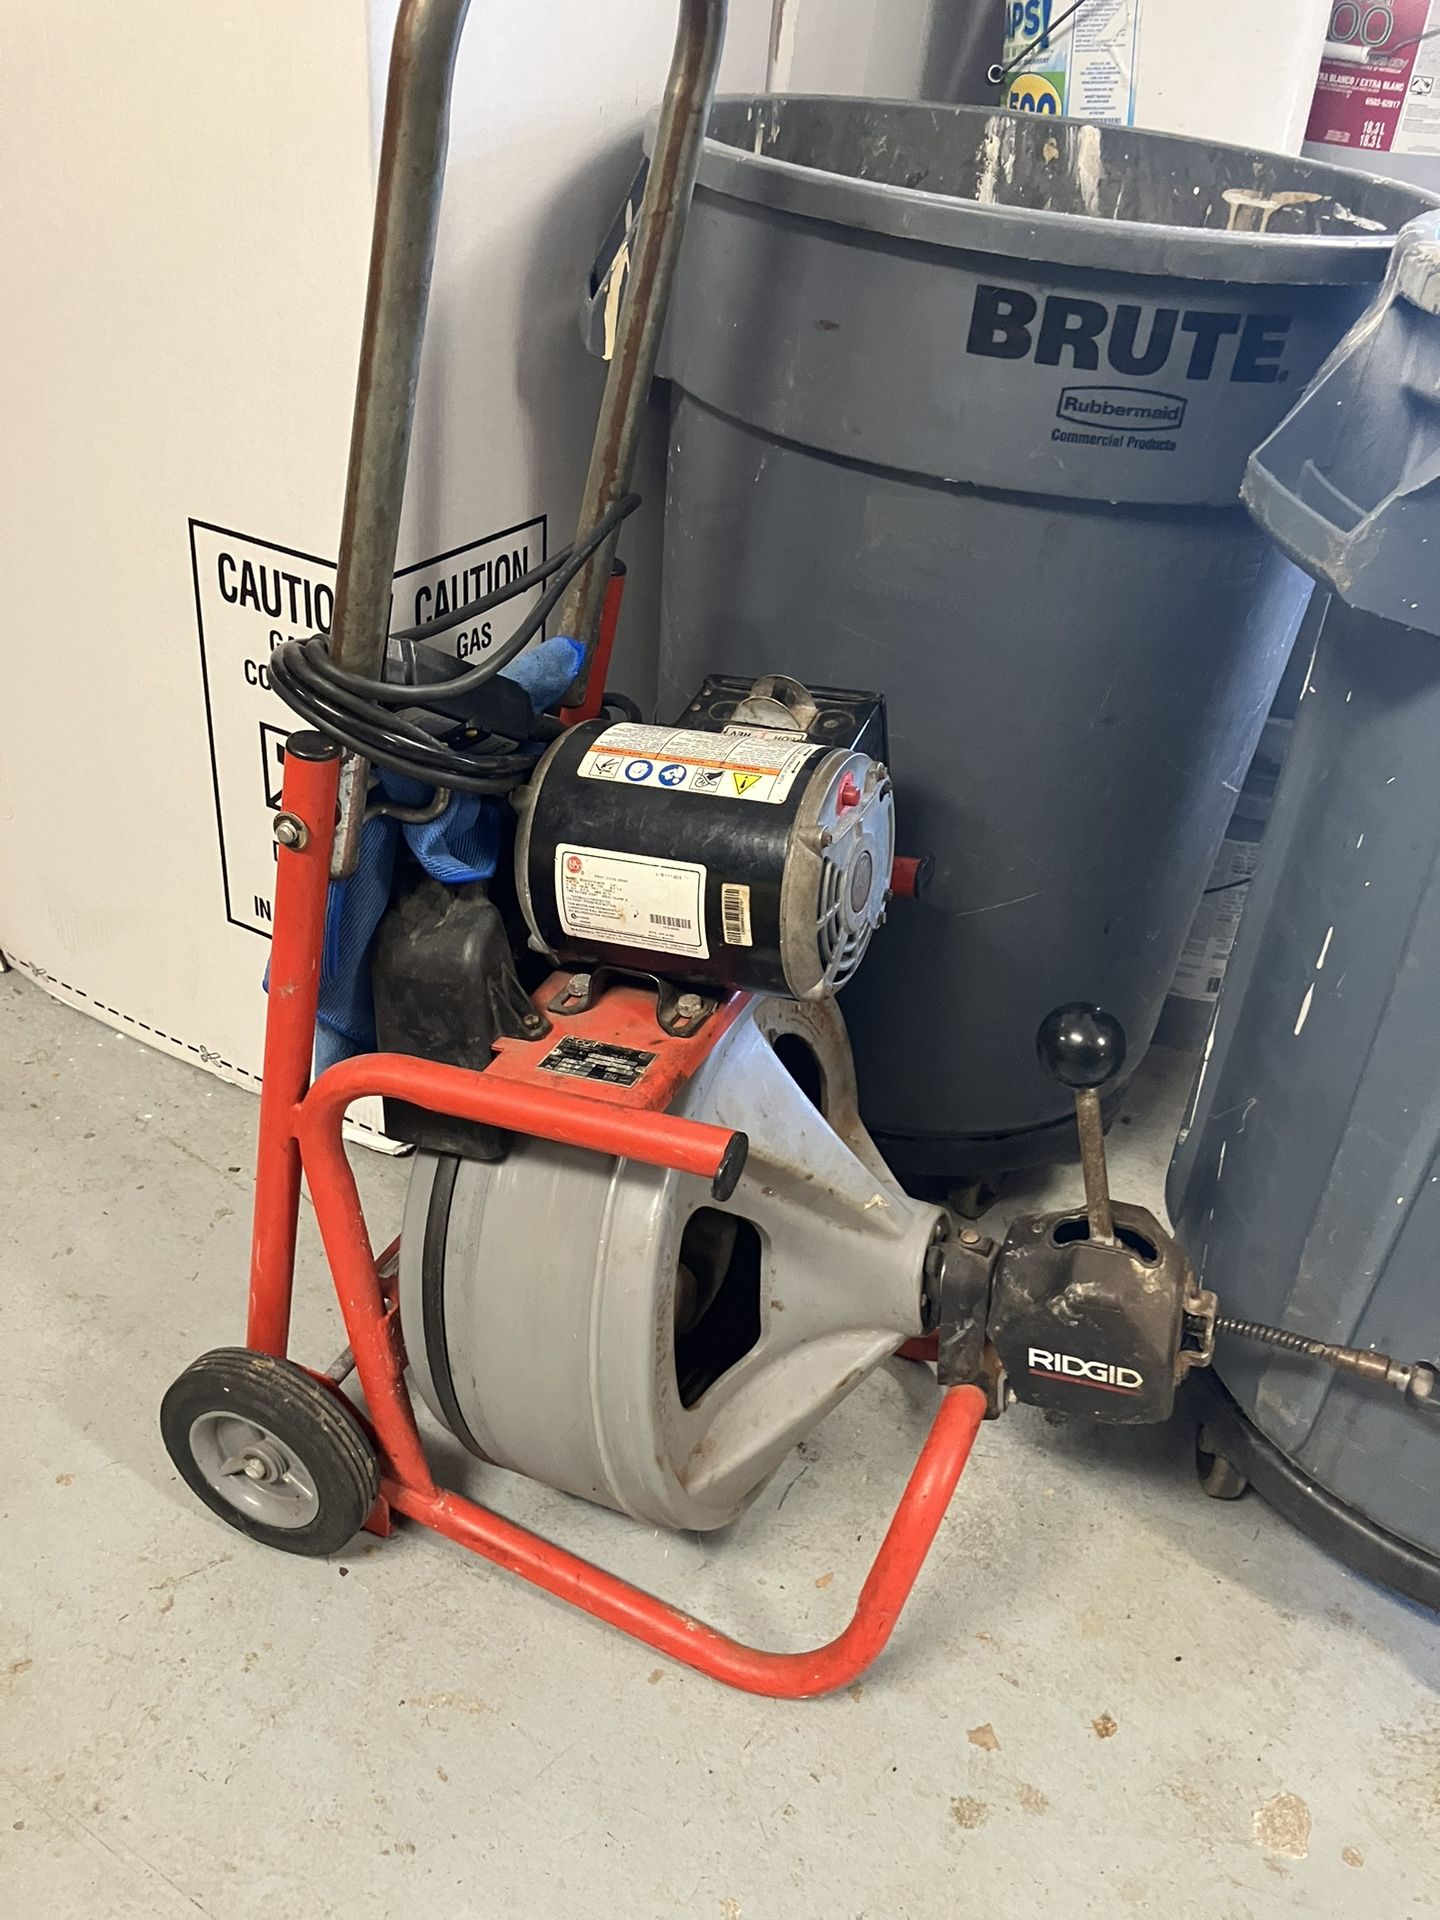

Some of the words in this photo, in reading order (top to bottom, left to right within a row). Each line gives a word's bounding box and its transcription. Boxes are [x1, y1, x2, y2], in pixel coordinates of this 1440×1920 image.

[1360, 78, 1381, 89] EXTRA
[1382, 81, 1405, 92] BLANC
[1063, 396, 1180, 421] Rubbermaid
[1051, 428, 1123, 447] Commercial
[1127, 436, 1177, 452] Products
[218, 552, 334, 634] CAUTIO
[457, 622, 492, 660] GAS
[1028, 1347, 1143, 1389] RIDGID
